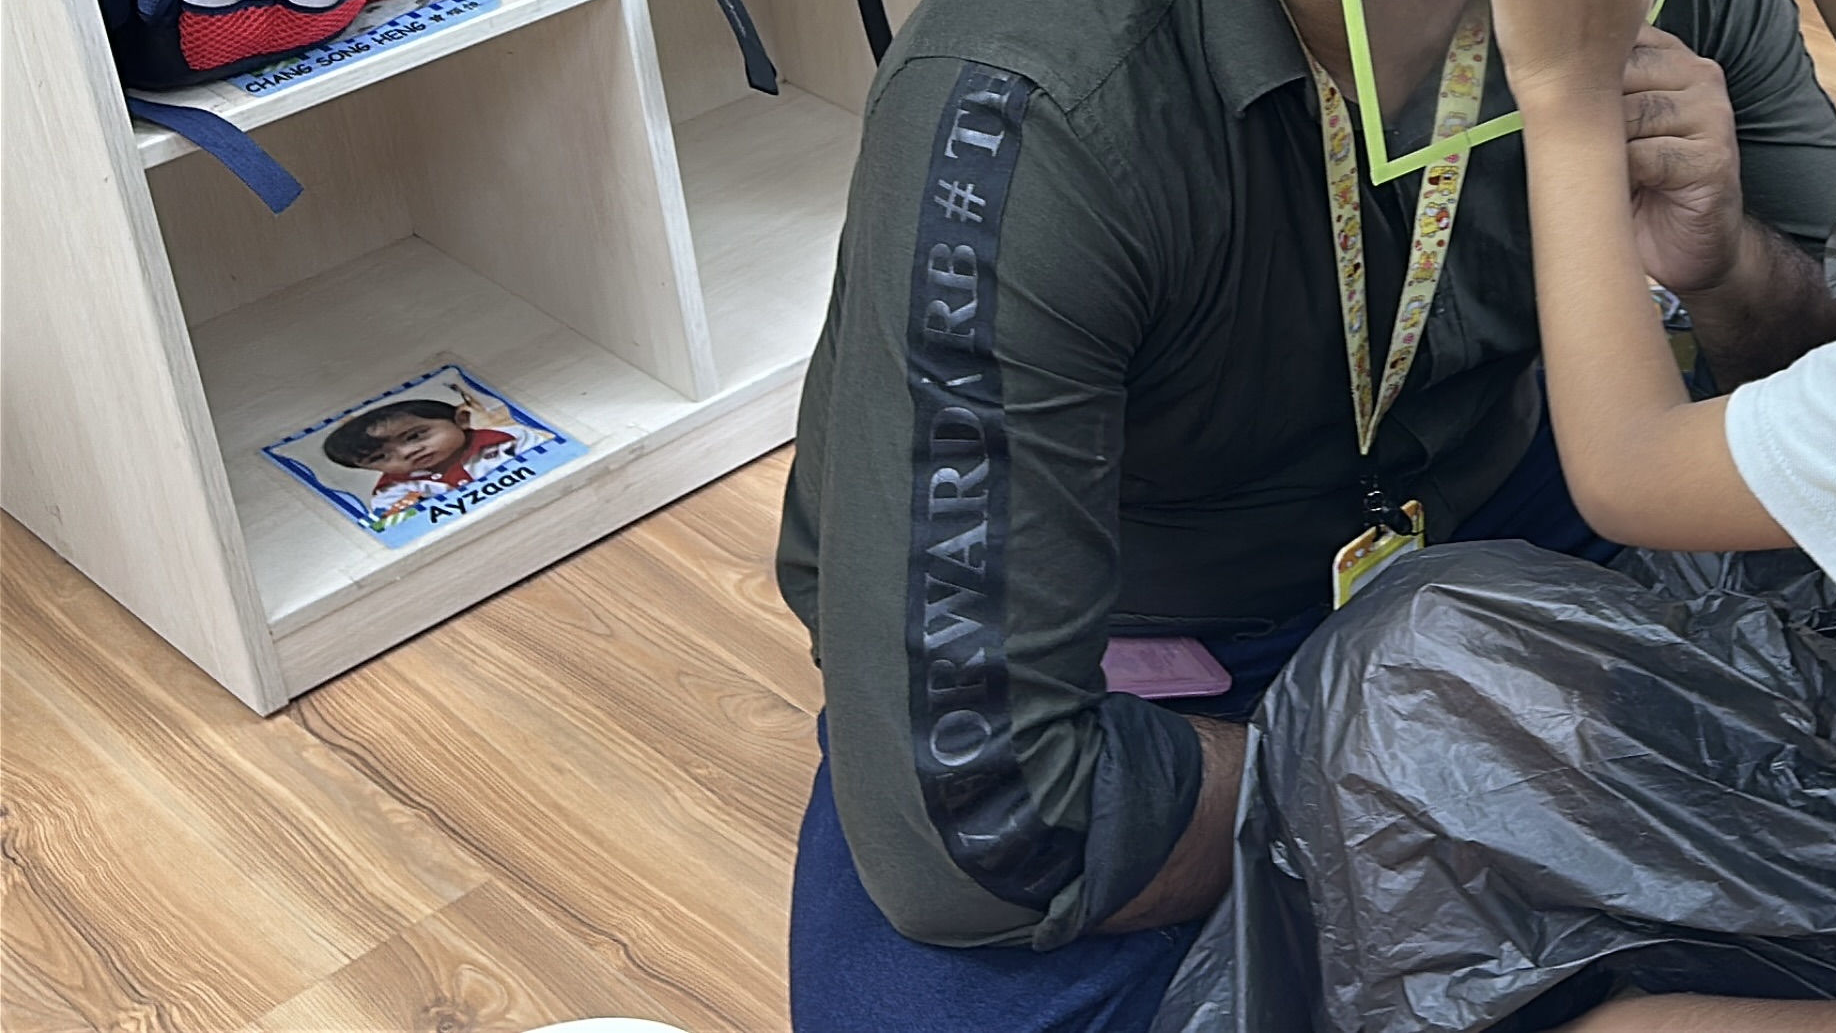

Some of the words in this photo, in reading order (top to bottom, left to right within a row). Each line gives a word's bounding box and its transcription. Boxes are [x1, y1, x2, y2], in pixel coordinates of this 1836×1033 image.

[246, 63, 313, 94] CHANG
[316, 42, 371, 67] SONG
[372, 21, 426, 46] HENG
[429, 466, 537, 524] Ayzaan
